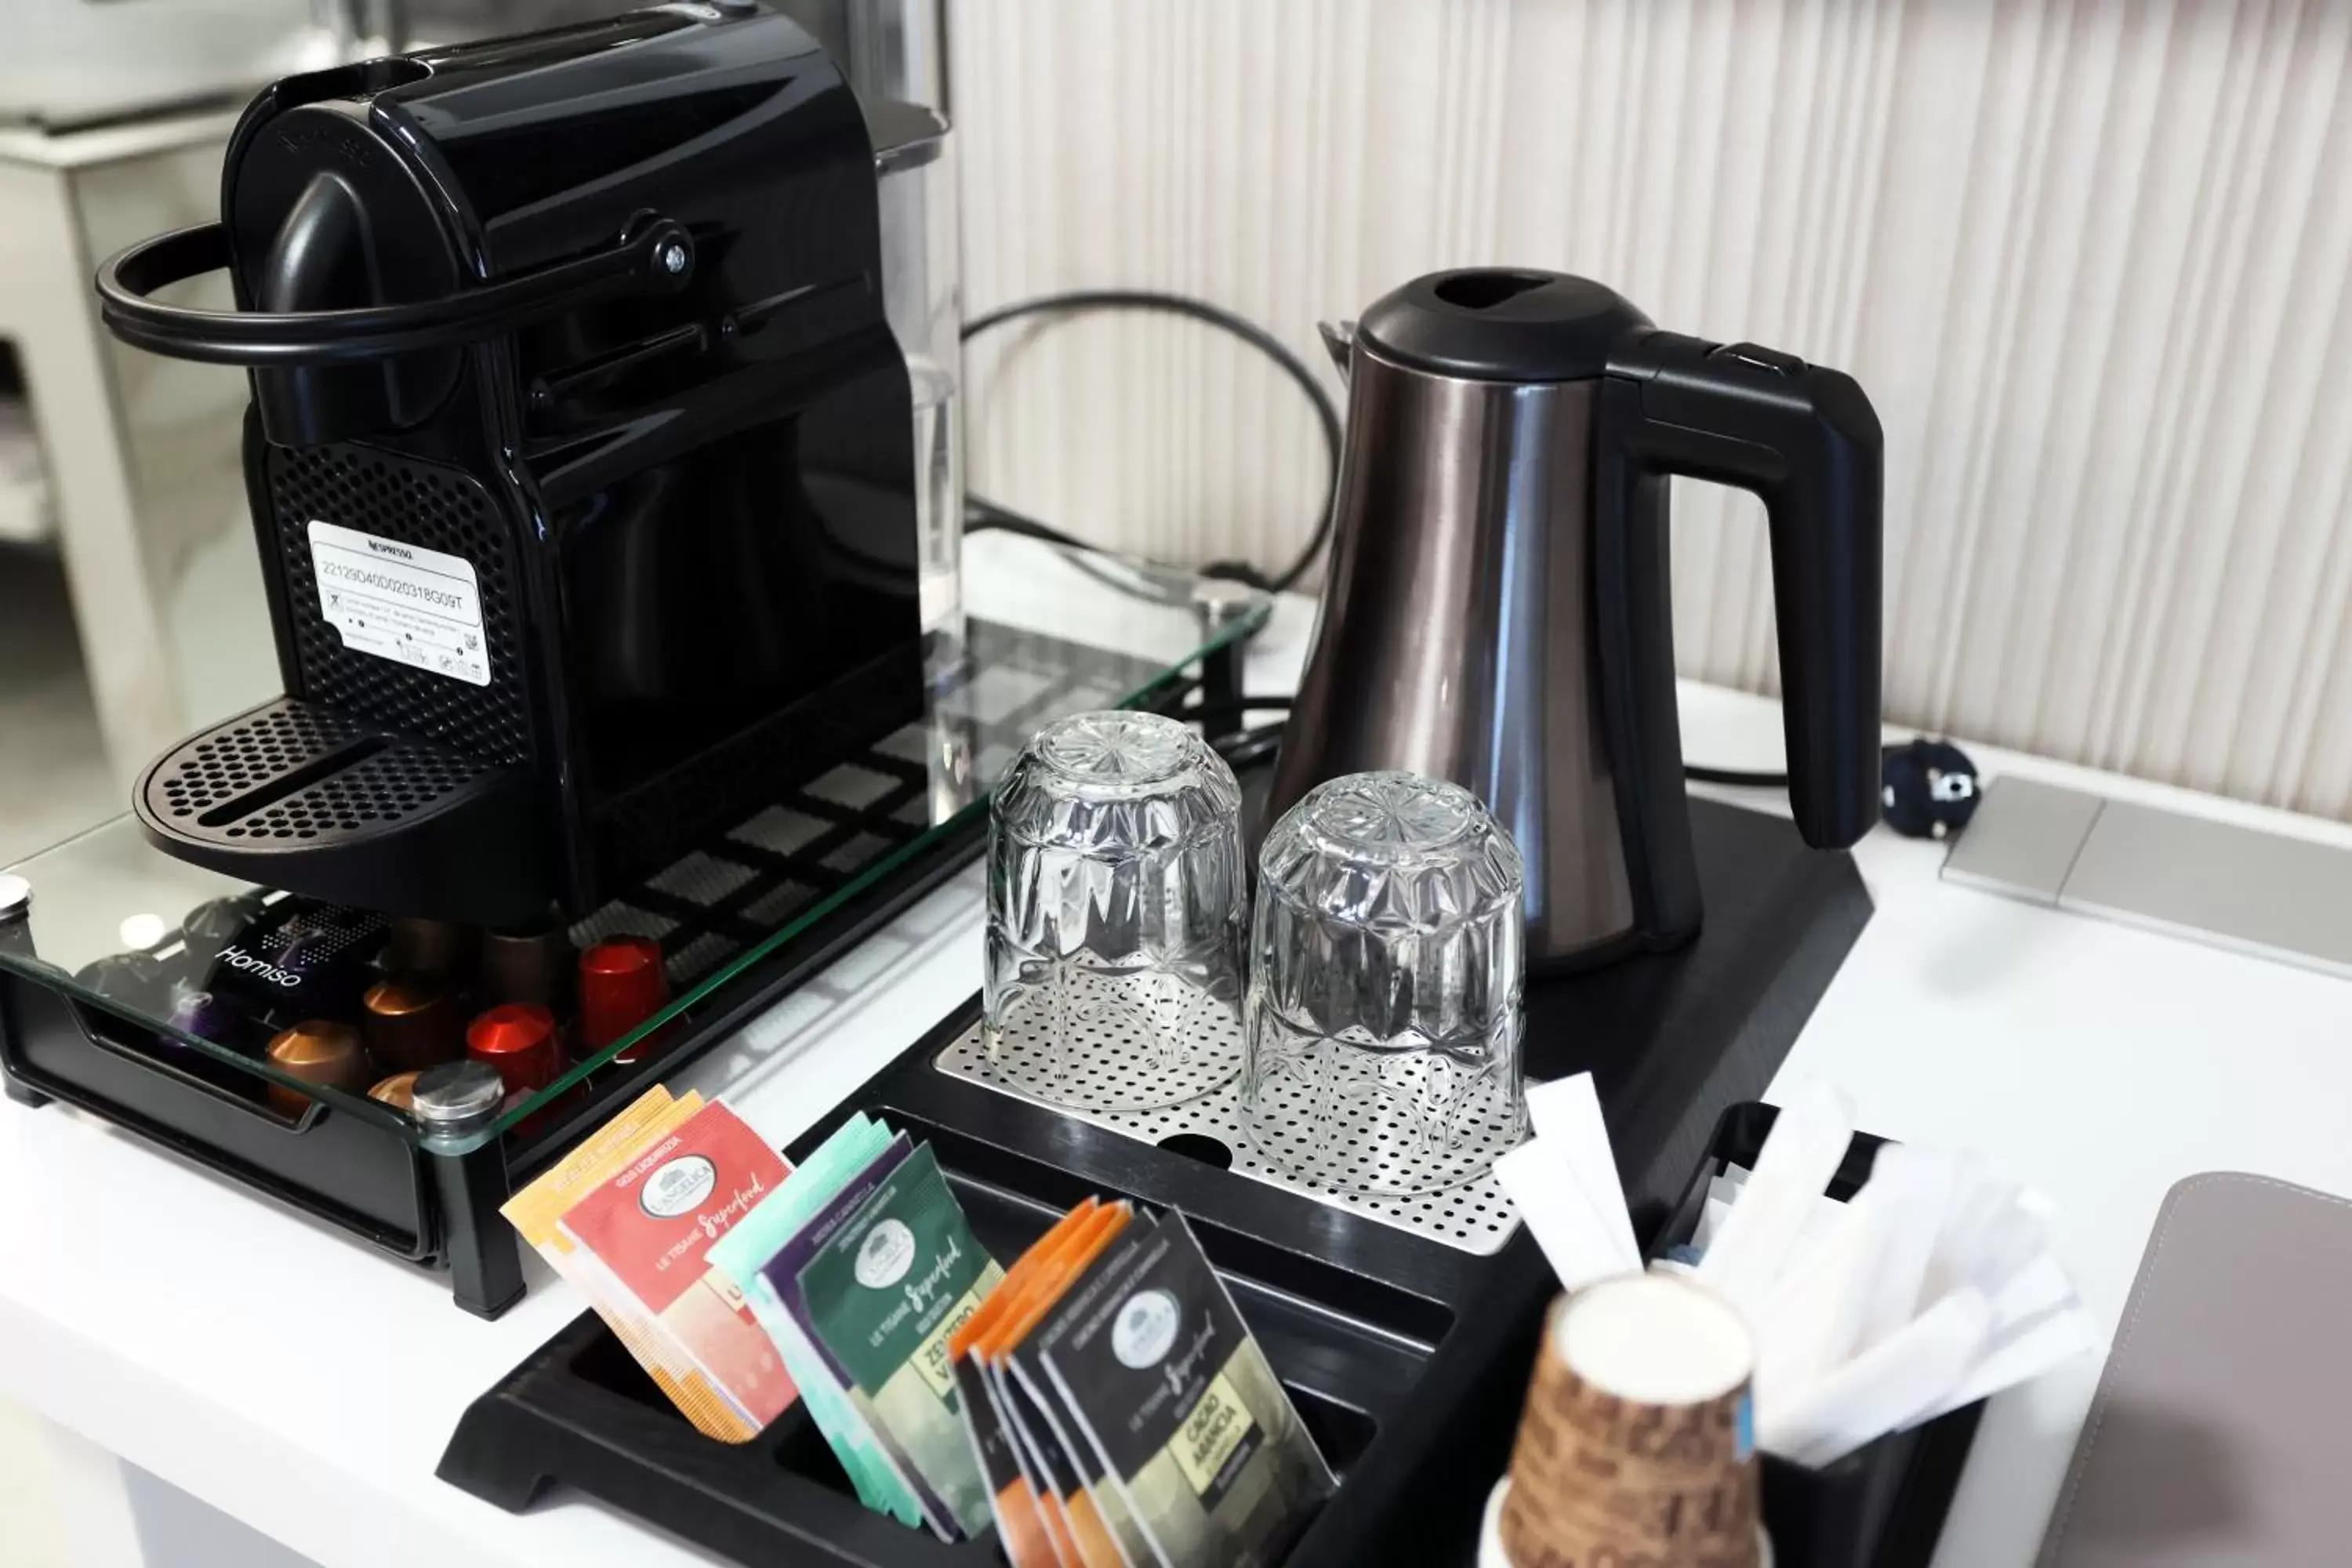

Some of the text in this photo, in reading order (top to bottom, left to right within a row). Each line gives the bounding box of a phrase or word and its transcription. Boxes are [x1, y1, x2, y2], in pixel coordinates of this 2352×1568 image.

[214, 945, 302, 987] Homiso
[698, 1171, 765, 1239] Superfood
[904, 1235, 961, 1313] Superfood
[1186, 1395, 1220, 1443] CACAO
